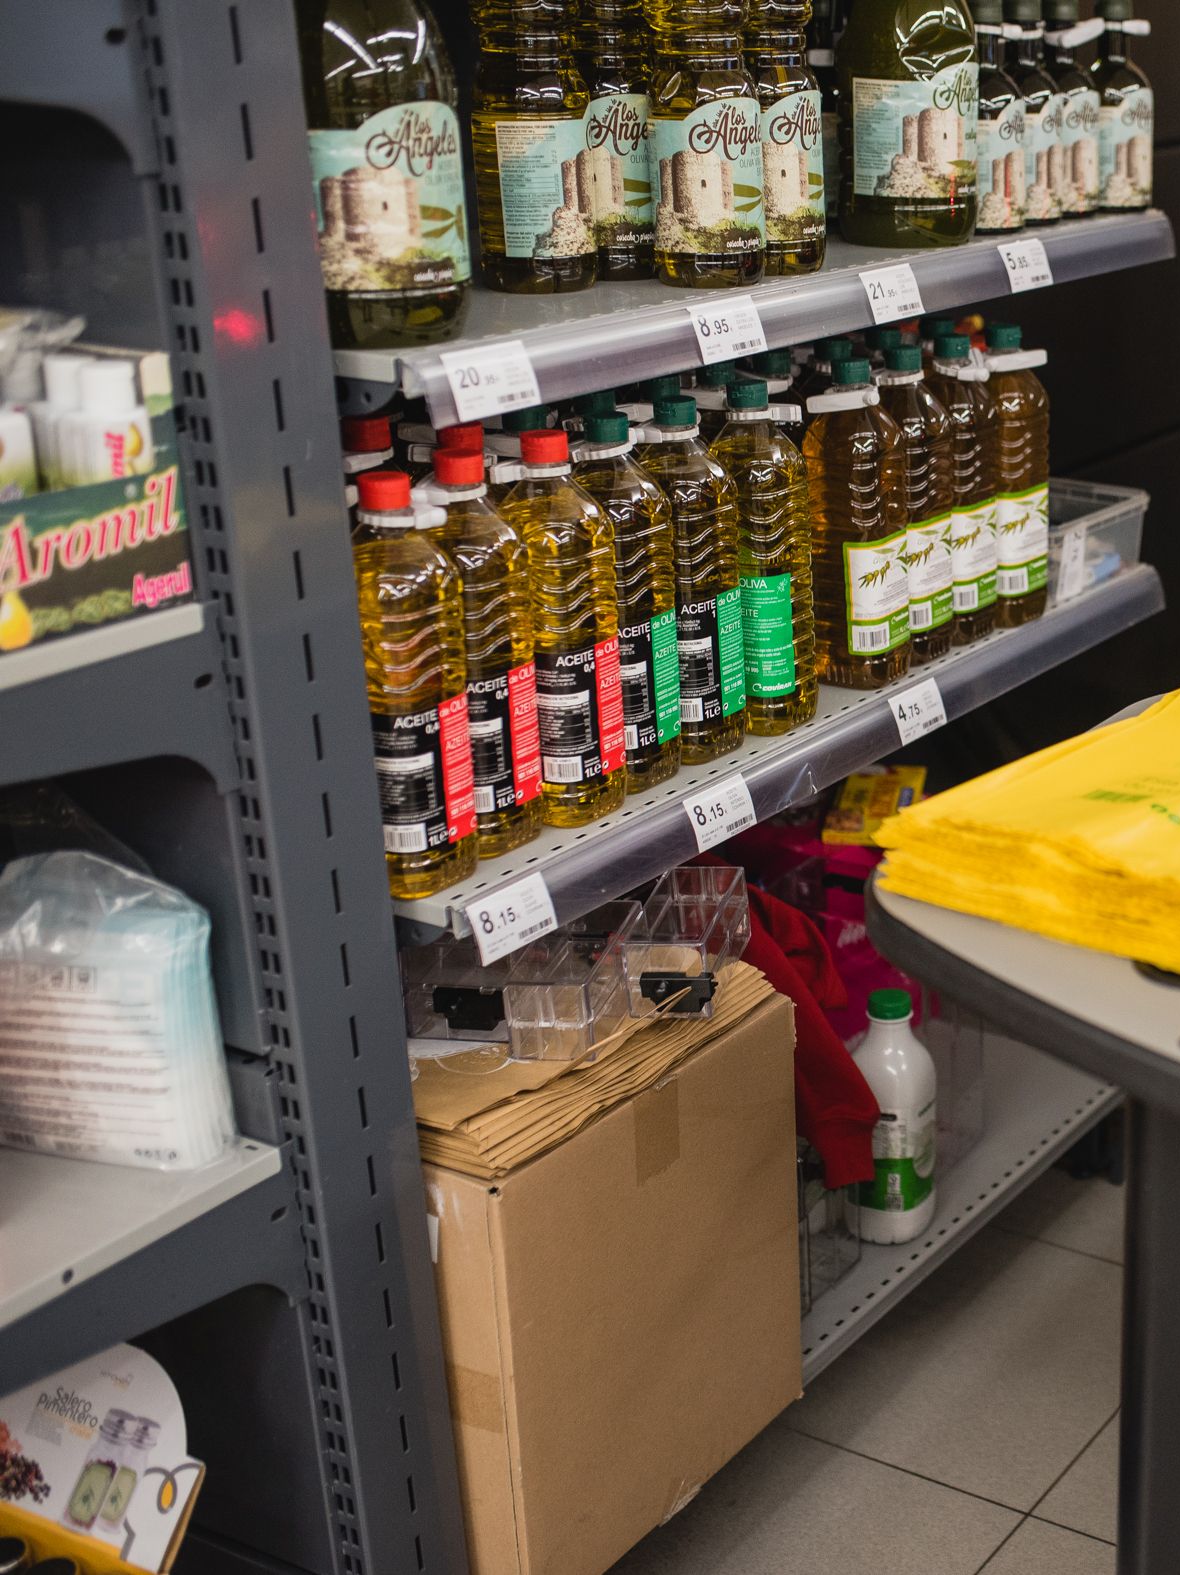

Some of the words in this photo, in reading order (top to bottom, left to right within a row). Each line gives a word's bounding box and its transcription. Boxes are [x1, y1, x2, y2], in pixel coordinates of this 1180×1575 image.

[621, 102, 640, 122] los
[731, 106, 746, 126] los
[0, 465, 180, 596] Aromil
[739, 577, 768, 589] OLIVA
[680, 598, 717, 616] ACEITE
[741, 608, 759, 618] EITE
[617, 621, 651, 639] ACEITE
[555, 649, 595, 668] ACEITE
[466, 675, 508, 694] ACEITE
[393, 708, 439, 730] ACEITE
[55, 1384, 93, 1414] Salero
[36, 1392, 99, 1429] Pimentero
